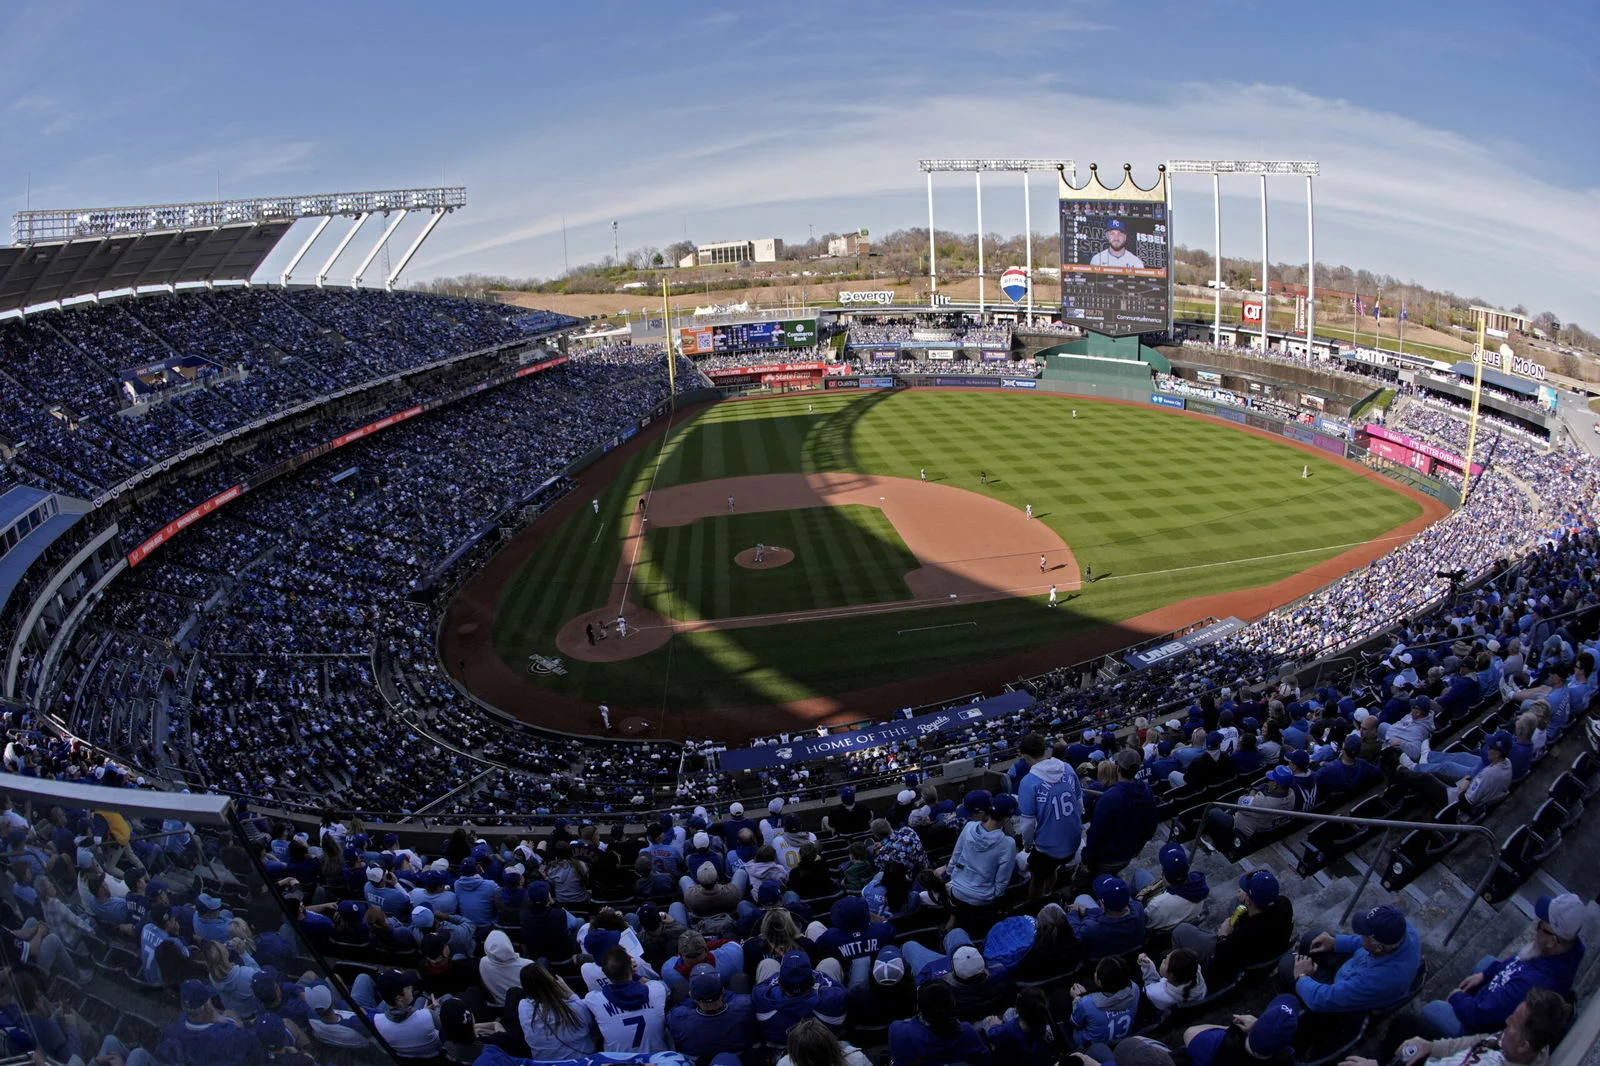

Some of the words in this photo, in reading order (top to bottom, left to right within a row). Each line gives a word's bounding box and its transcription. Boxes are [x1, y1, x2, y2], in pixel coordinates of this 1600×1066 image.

[1136, 232, 1166, 245] ISBEL
[1154, 224, 1166, 233] 28
[853, 292, 894, 303] evergy
[1244, 304, 1262, 320] QT
[1355, 347, 1388, 365] PATIO
[1513, 356, 1545, 380] MOON
[1419, 443, 1439, 458] BETTER
[1439, 452, 1453, 463] OVER
[1137, 641, 1186, 663] UMB
[806, 737, 853, 754] HOME
[856, 732, 876, 744] OF
[878, 726, 910, 739] THE
[916, 714, 951, 734] Royals
[1051, 791, 1074, 821] 16
[838, 940, 863, 958] WITT
[622, 1015, 647, 1048] 7
[1107, 1014, 1133, 1041] 13
